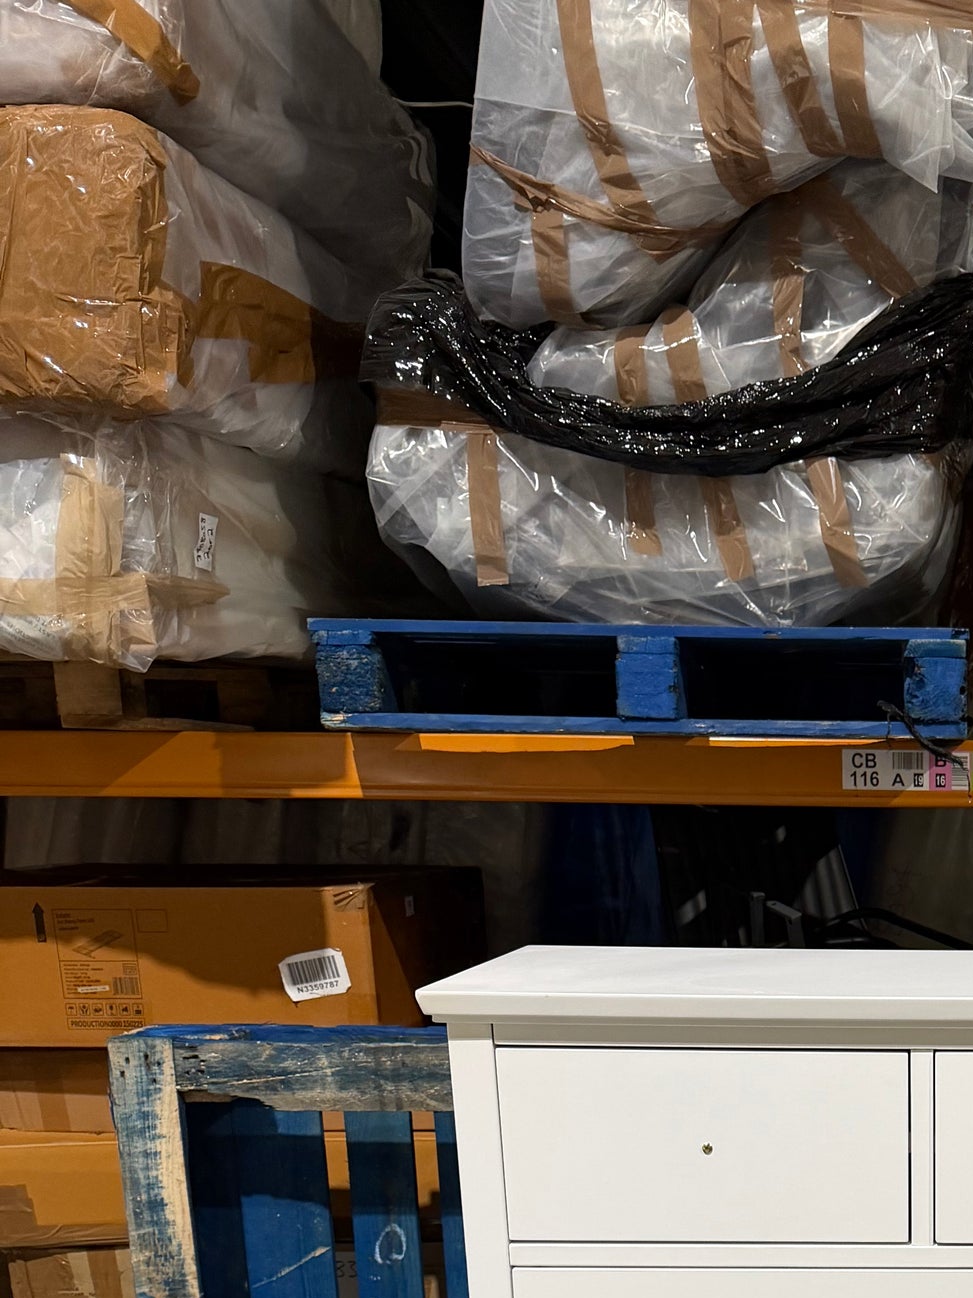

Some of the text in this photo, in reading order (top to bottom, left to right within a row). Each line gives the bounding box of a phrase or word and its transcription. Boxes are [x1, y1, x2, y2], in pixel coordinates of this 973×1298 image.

[851, 752, 877, 769] CB
[850, 770, 880, 787] 116
[892, 773, 924, 787] A 19
[935, 773, 947, 787] 16
[297, 980, 340, 994] N3359787
